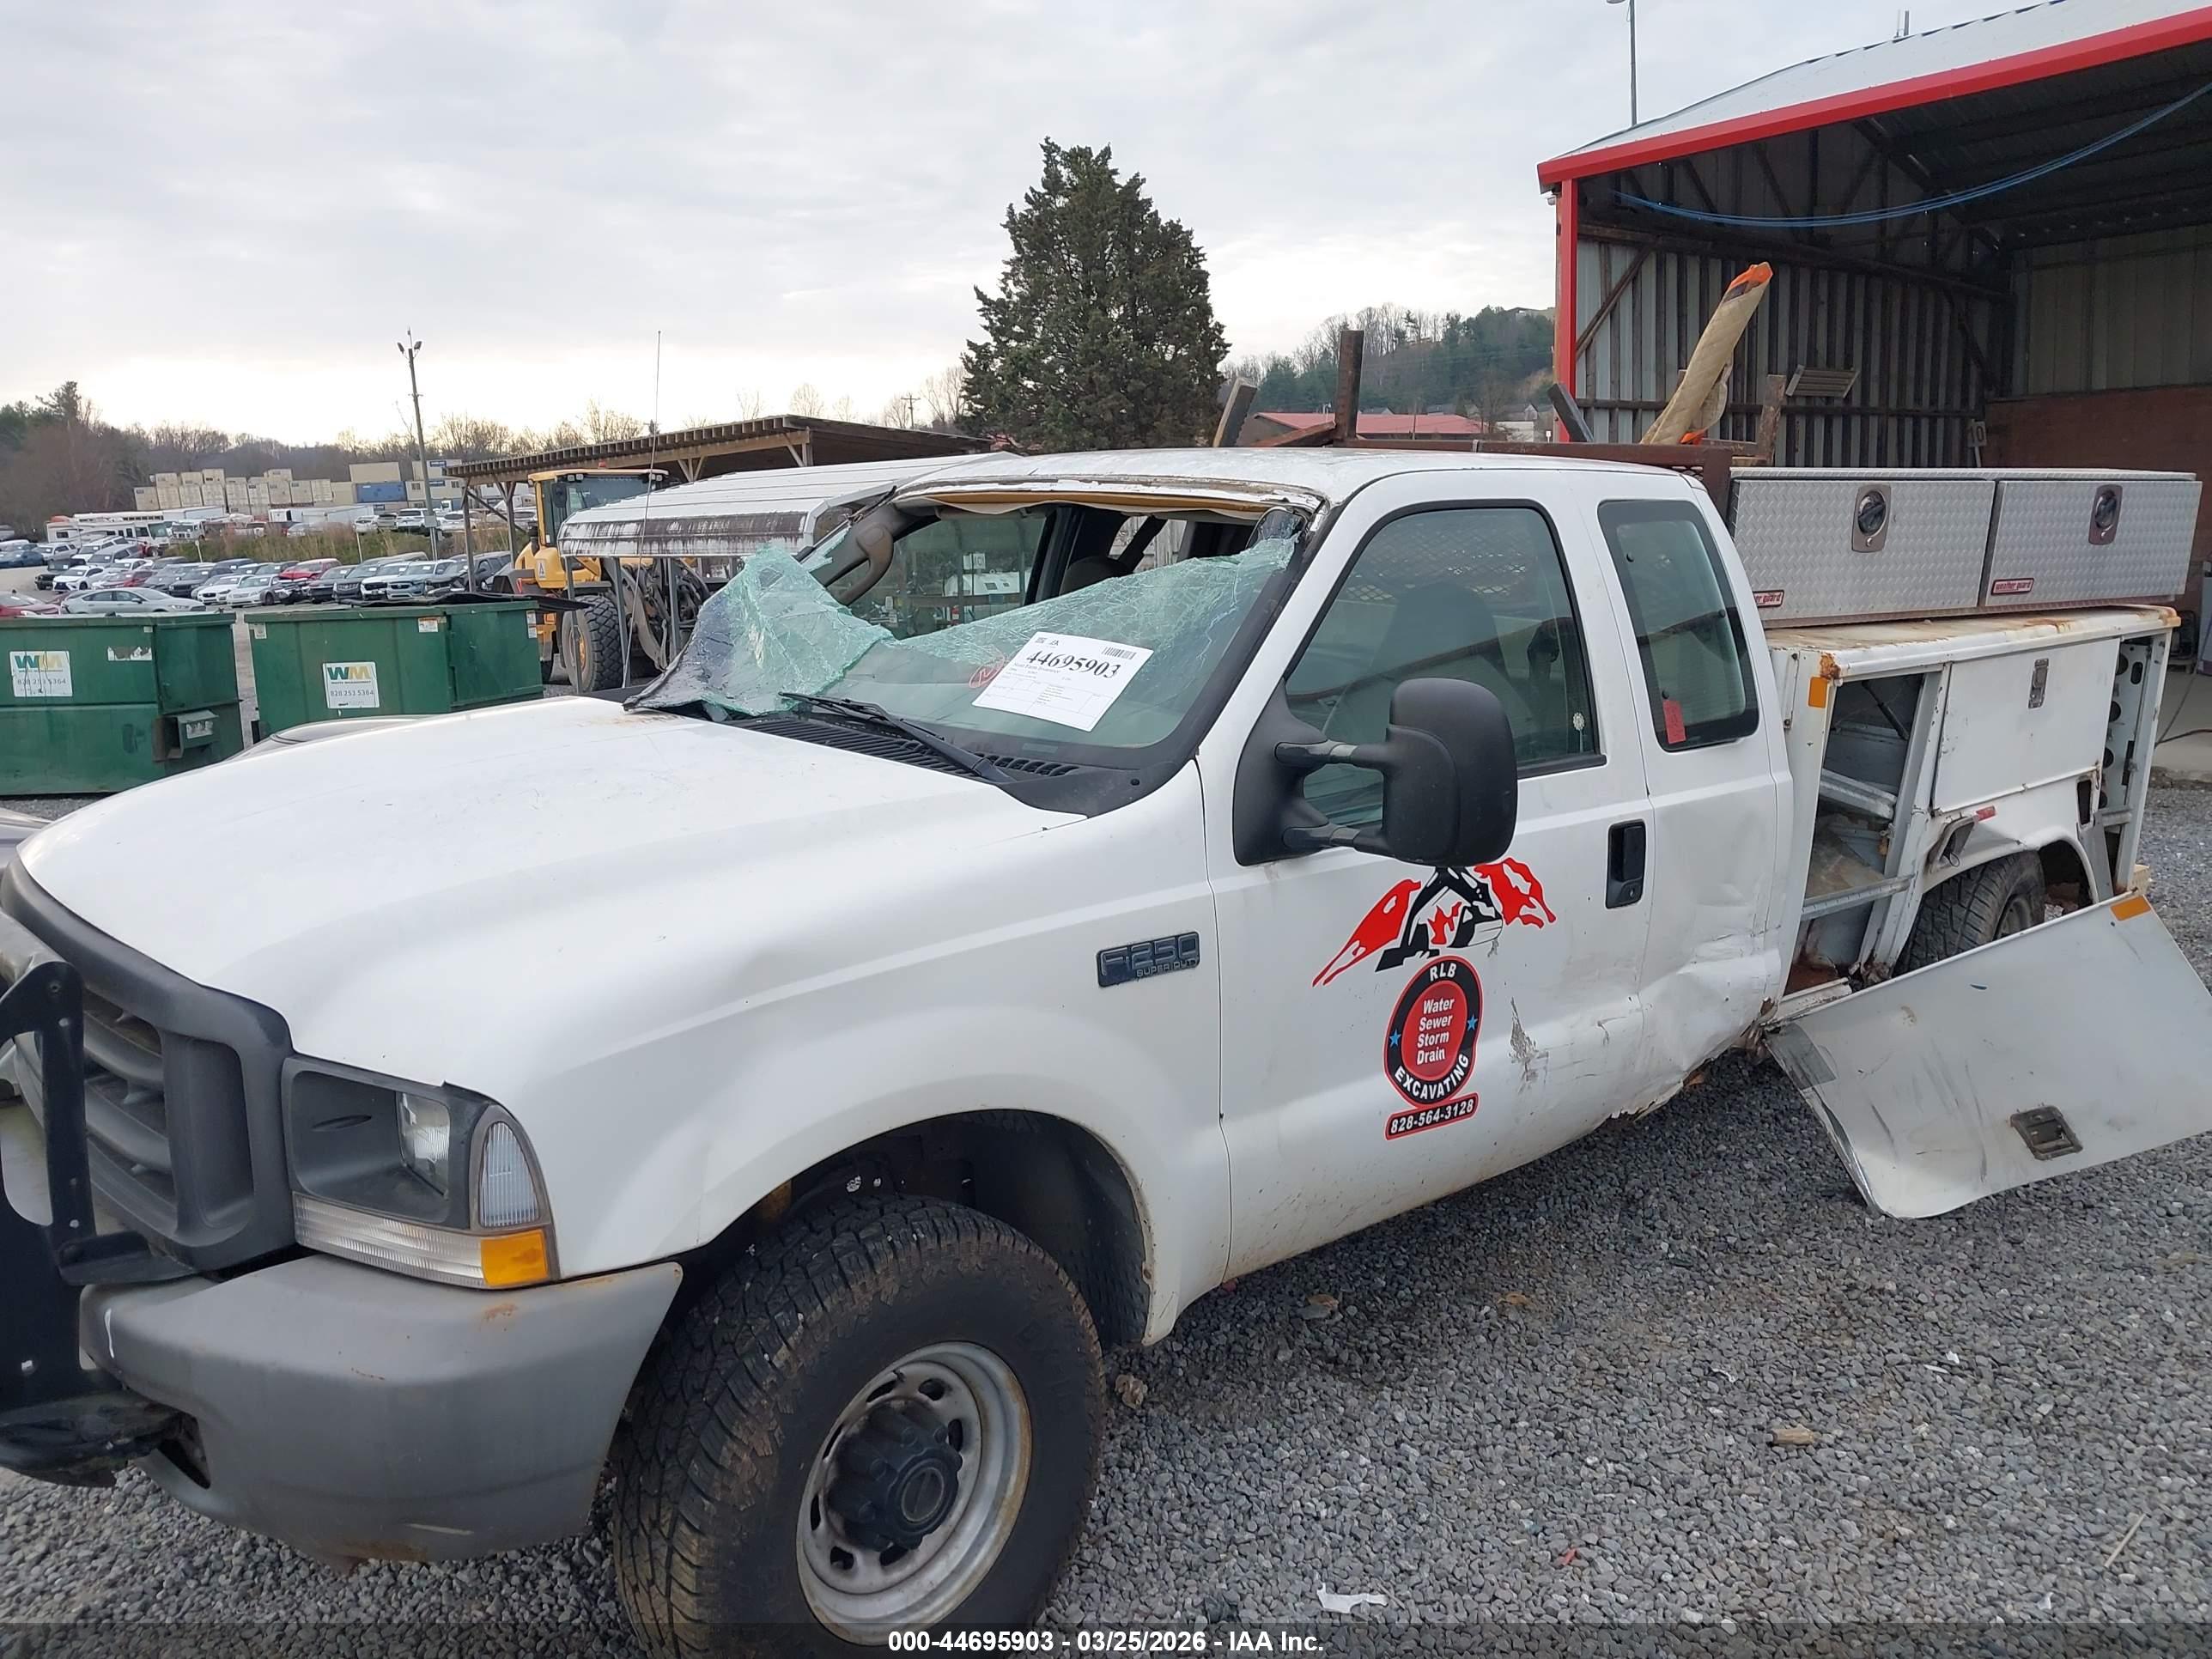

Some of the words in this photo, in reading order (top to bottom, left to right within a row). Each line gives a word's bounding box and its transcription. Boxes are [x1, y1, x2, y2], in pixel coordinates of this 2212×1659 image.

[327, 665, 372, 680] WM
[1026, 650, 1122, 678] 44695903
[1136, 963, 1171, 977] SUPER
[1429, 963, 1458, 981] RLB
[1423, 998, 1455, 1015] Water
[1419, 1015, 1453, 1031] Sewer
[1417, 1031, 1449, 1048] Storm
[1416, 1048, 1445, 1065] Drain
[1395, 1054, 1469, 1099] EXCAVATING
[1390, 1098, 1474, 1133] 828-564-3128
